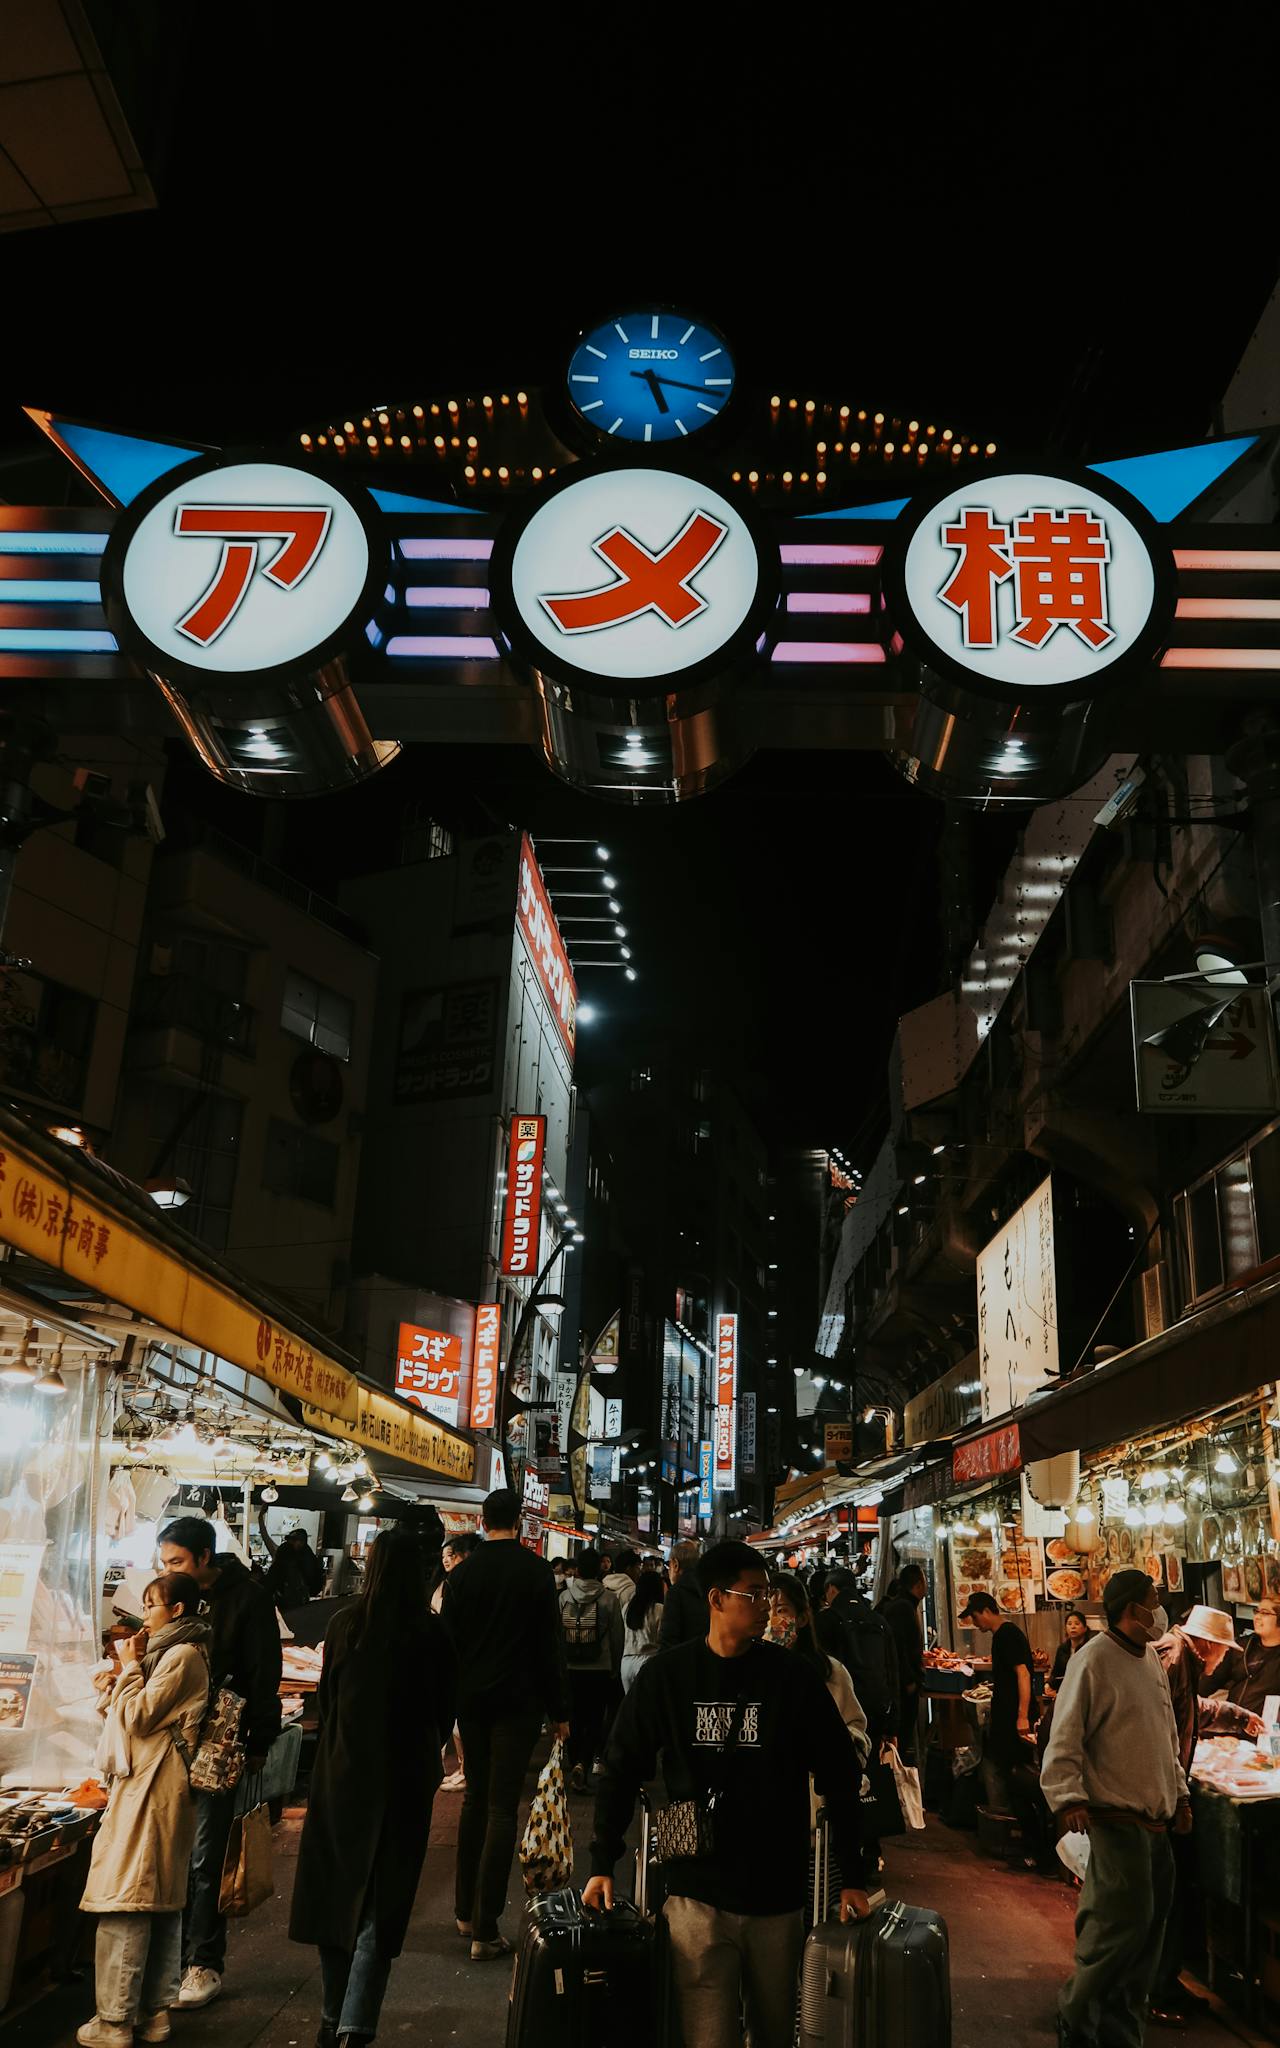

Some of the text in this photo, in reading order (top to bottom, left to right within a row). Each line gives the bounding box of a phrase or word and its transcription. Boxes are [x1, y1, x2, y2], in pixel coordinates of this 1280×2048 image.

[628, 348, 679, 360] SEIKO
[174, 503, 1117, 652] ア メ 横
[396, 1061, 491, 1095] サンドラッグ
[519, 1121, 537, 1138] 薬
[510, 1163, 535, 1271] サンドラッグ
[411, 1334, 452, 1362] スギ
[473, 1306, 498, 1425] スギドラッグ
[719, 1324, 734, 1386] カラオケ
[397, 1357, 461, 1393] ドラッグ
[696, 1705, 758, 1719] MARIÉ
